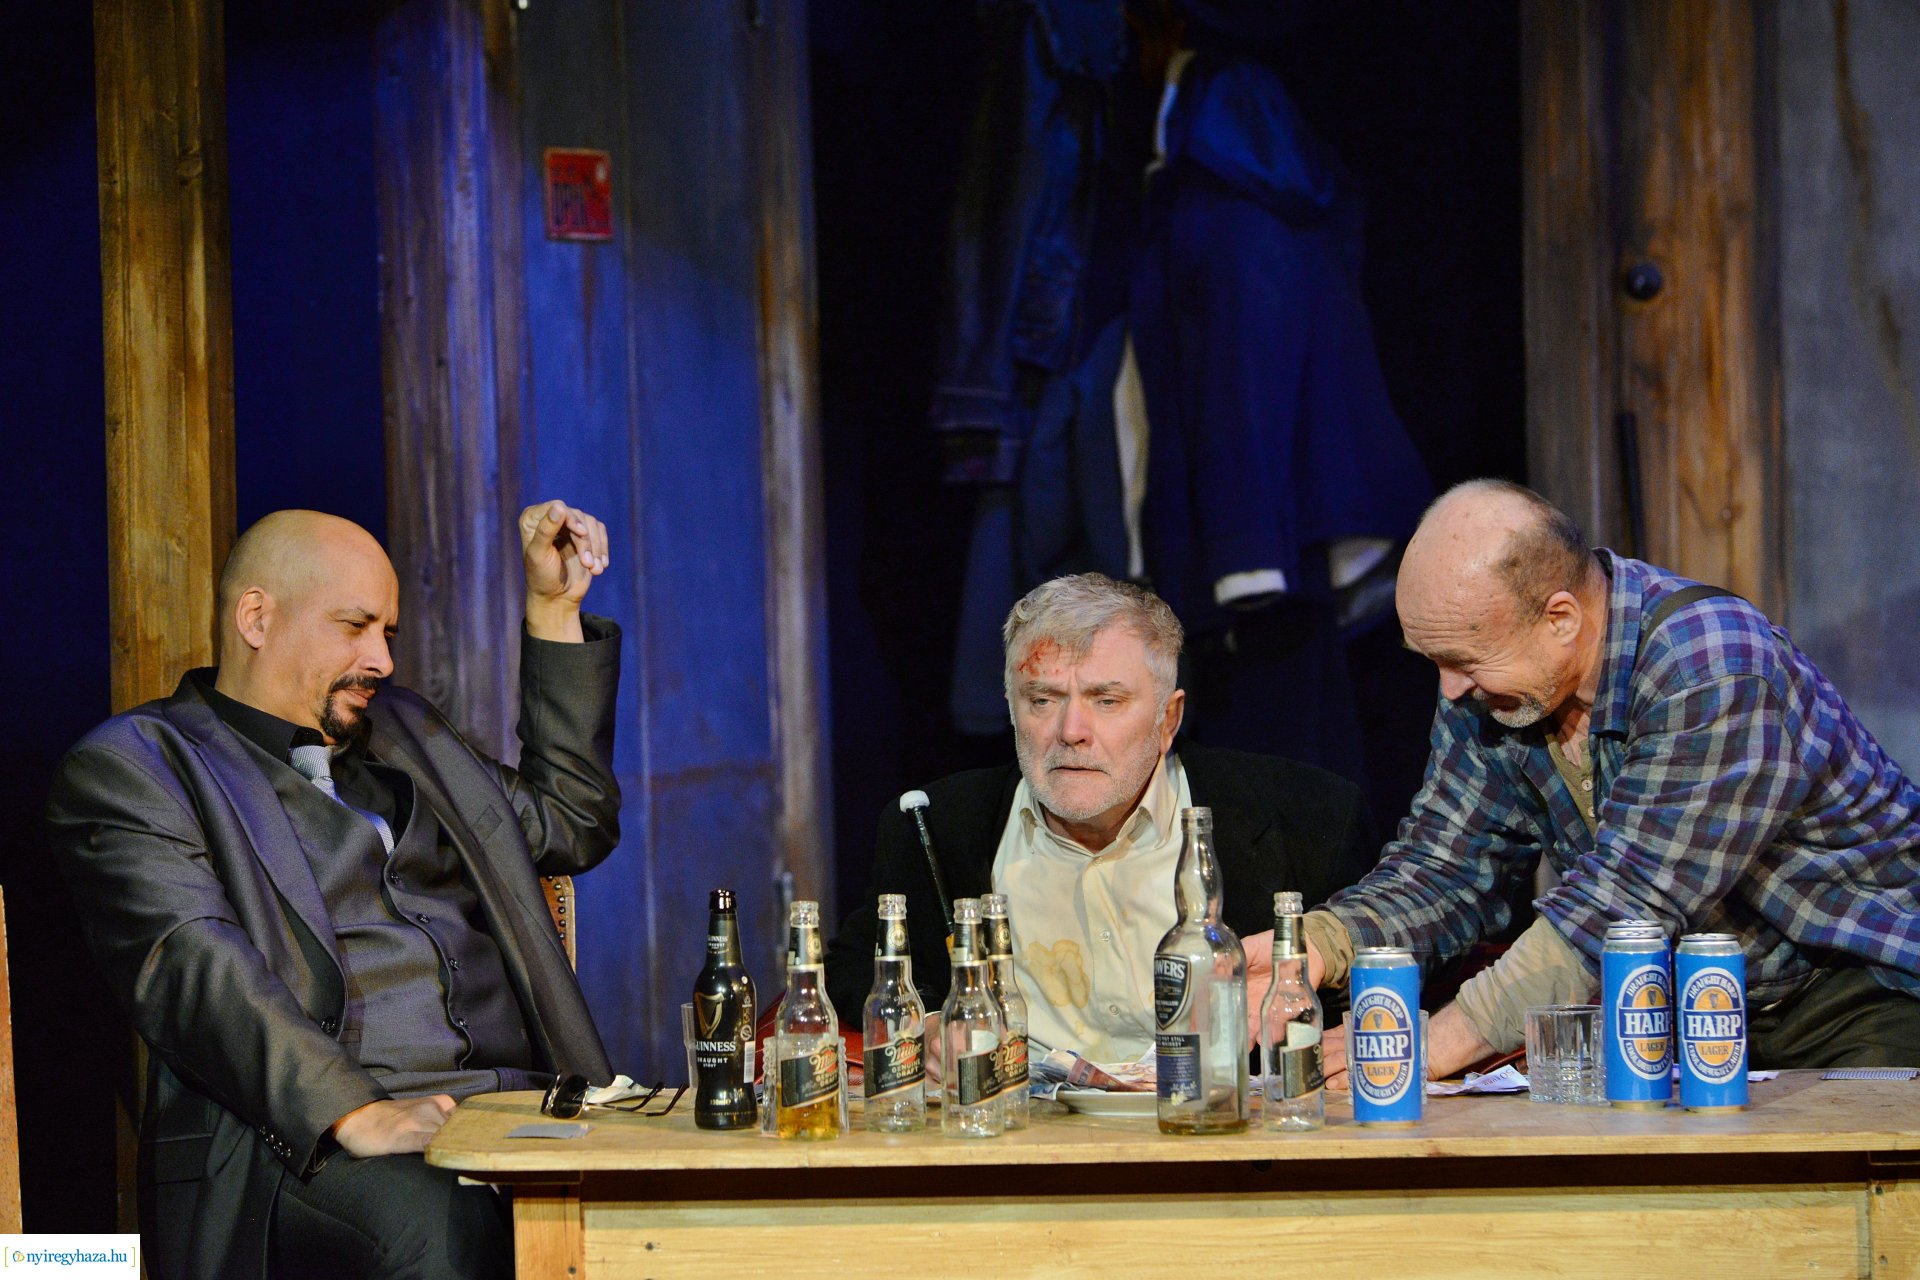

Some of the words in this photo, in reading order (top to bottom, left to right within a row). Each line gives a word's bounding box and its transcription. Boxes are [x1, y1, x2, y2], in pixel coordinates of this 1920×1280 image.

[1155, 960, 1186, 980] WERS
[1686, 1014, 1742, 1038] HARP
[696, 1041, 737, 1052] UINNESS
[1355, 1034, 1409, 1058] HARP
[1640, 1042, 1665, 1053] LAGER
[1701, 1045, 1729, 1056] LAGER
[885, 1043, 922, 1067] Miller
[1367, 1065, 1395, 1077] LAGER
